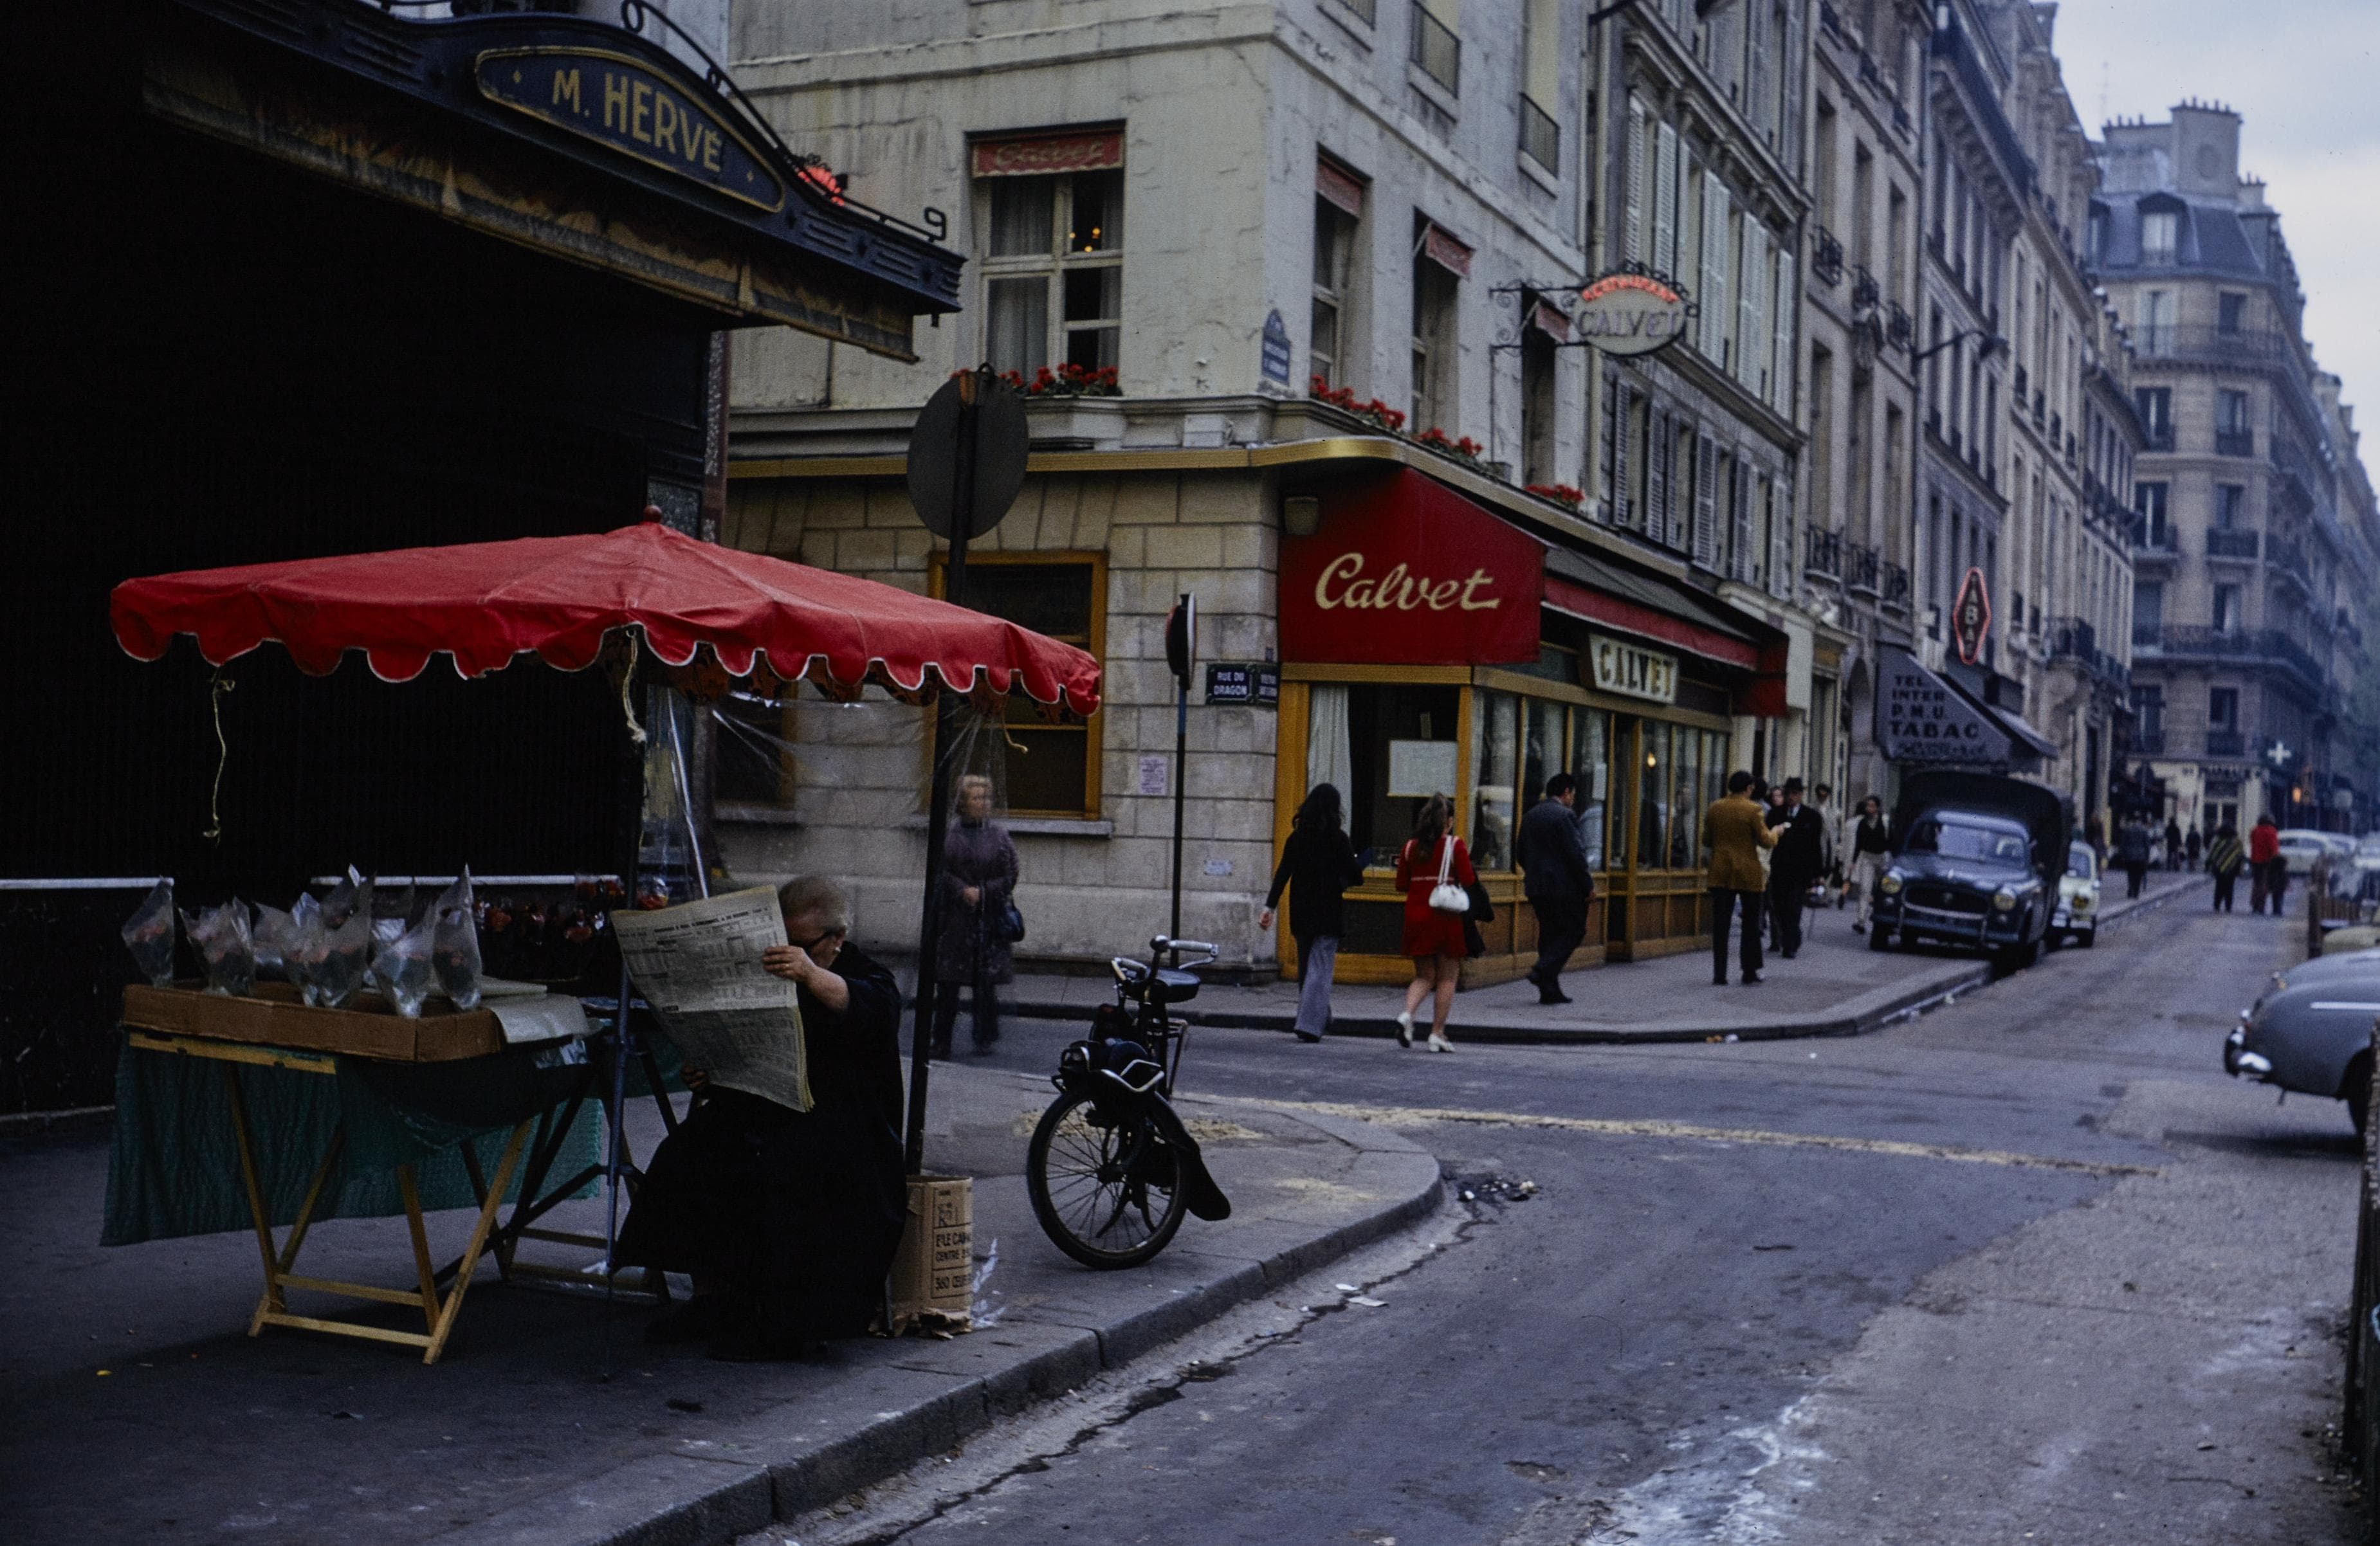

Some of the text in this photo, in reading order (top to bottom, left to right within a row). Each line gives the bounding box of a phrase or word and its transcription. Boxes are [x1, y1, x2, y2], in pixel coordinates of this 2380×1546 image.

[552, 69, 590, 117] M.
[1578, 309, 1681, 337] CALVET
[1315, 552, 1500, 610] Calvet
[1216, 671, 1245, 682] RUE DU
[1600, 643, 1673, 696] CALVET
[1213, 685, 1247, 695] DRAGON
[1890, 720, 1980, 739] TABAC
